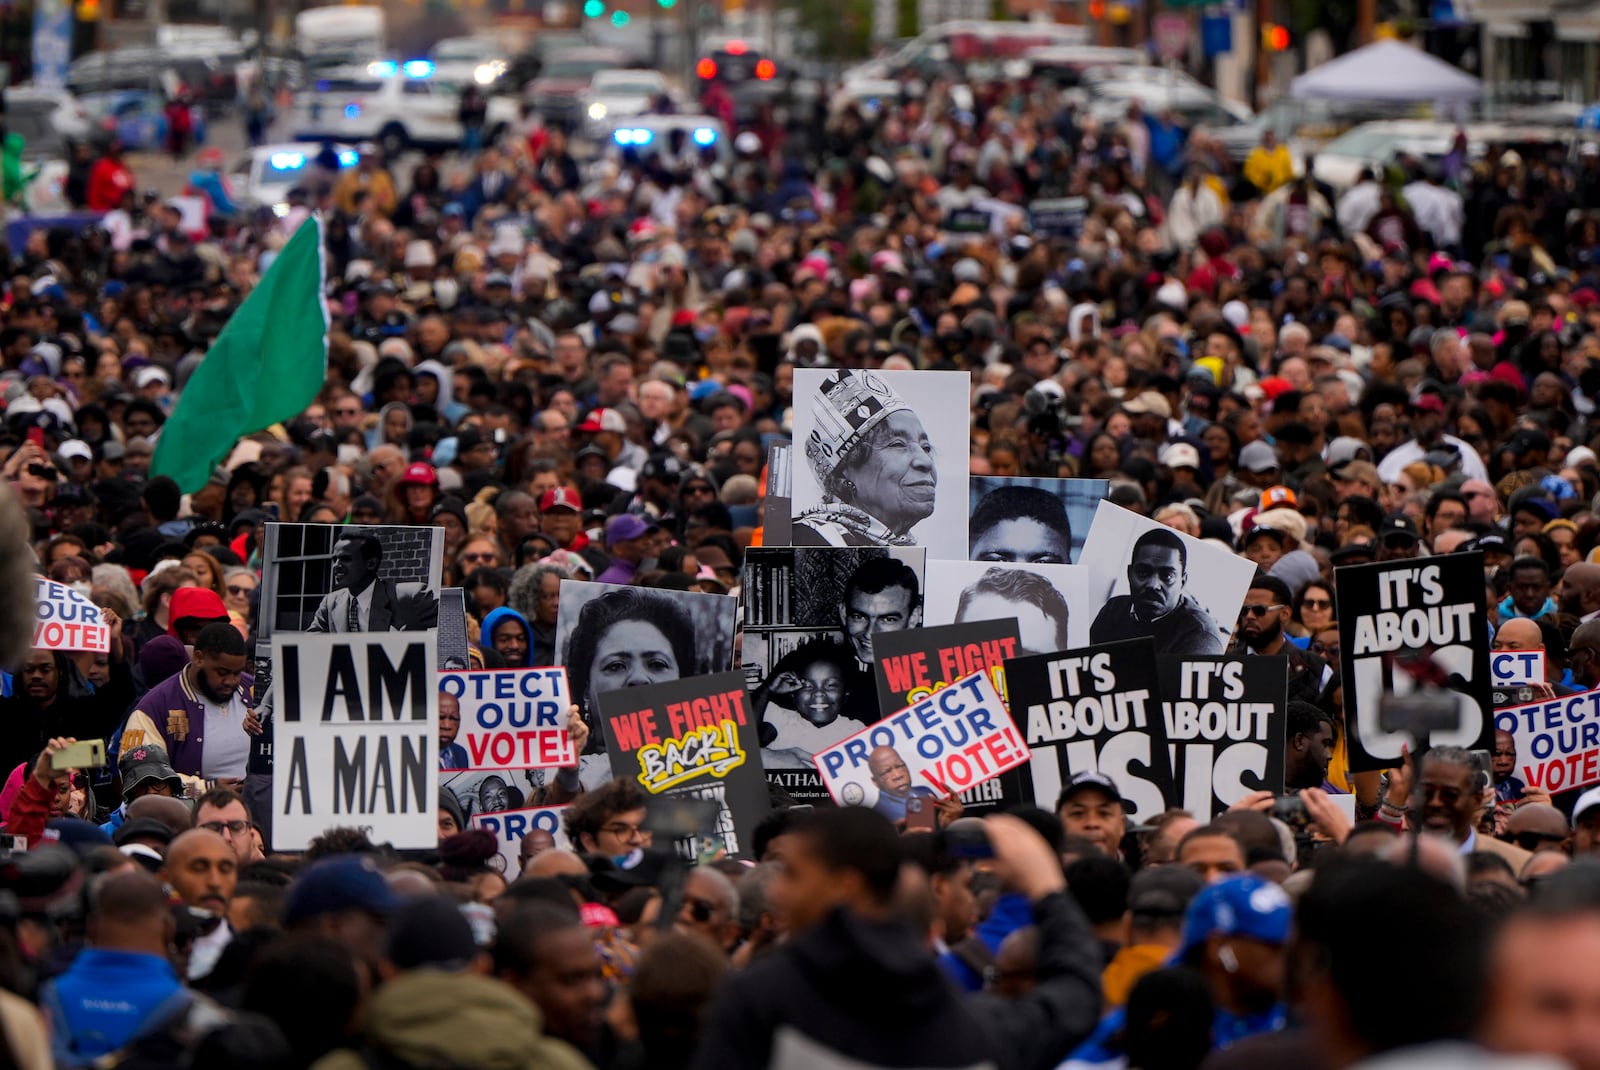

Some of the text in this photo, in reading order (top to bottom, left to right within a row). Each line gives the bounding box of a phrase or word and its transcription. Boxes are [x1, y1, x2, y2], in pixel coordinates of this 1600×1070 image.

[36, 601, 98, 624] OUR
[1379, 565, 1444, 610] IT'S
[1353, 603, 1476, 655] ABOUT
[282, 642, 428, 722] I AM
[438, 671, 562, 700] OTECT
[881, 651, 932, 693] WE
[938, 637, 1016, 687] FIGHT
[1048, 653, 1116, 699] IT'S
[1180, 661, 1244, 700] IT'S
[1492, 654, 1539, 679] CT
[476, 701, 559, 729] OUR
[609, 689, 747, 752] WE FIGHT
[822, 674, 985, 780] PROTECT
[917, 707, 997, 760] OUR
[1027, 689, 1150, 744] ABOUT
[1531, 722, 1600, 760] OUR
[467, 730, 570, 767] VOTE!
[640, 721, 741, 784] BACK!
[920, 727, 1024, 796] VOTE!
[283, 735, 428, 815] A MAN
[1030, 731, 1166, 827] US
